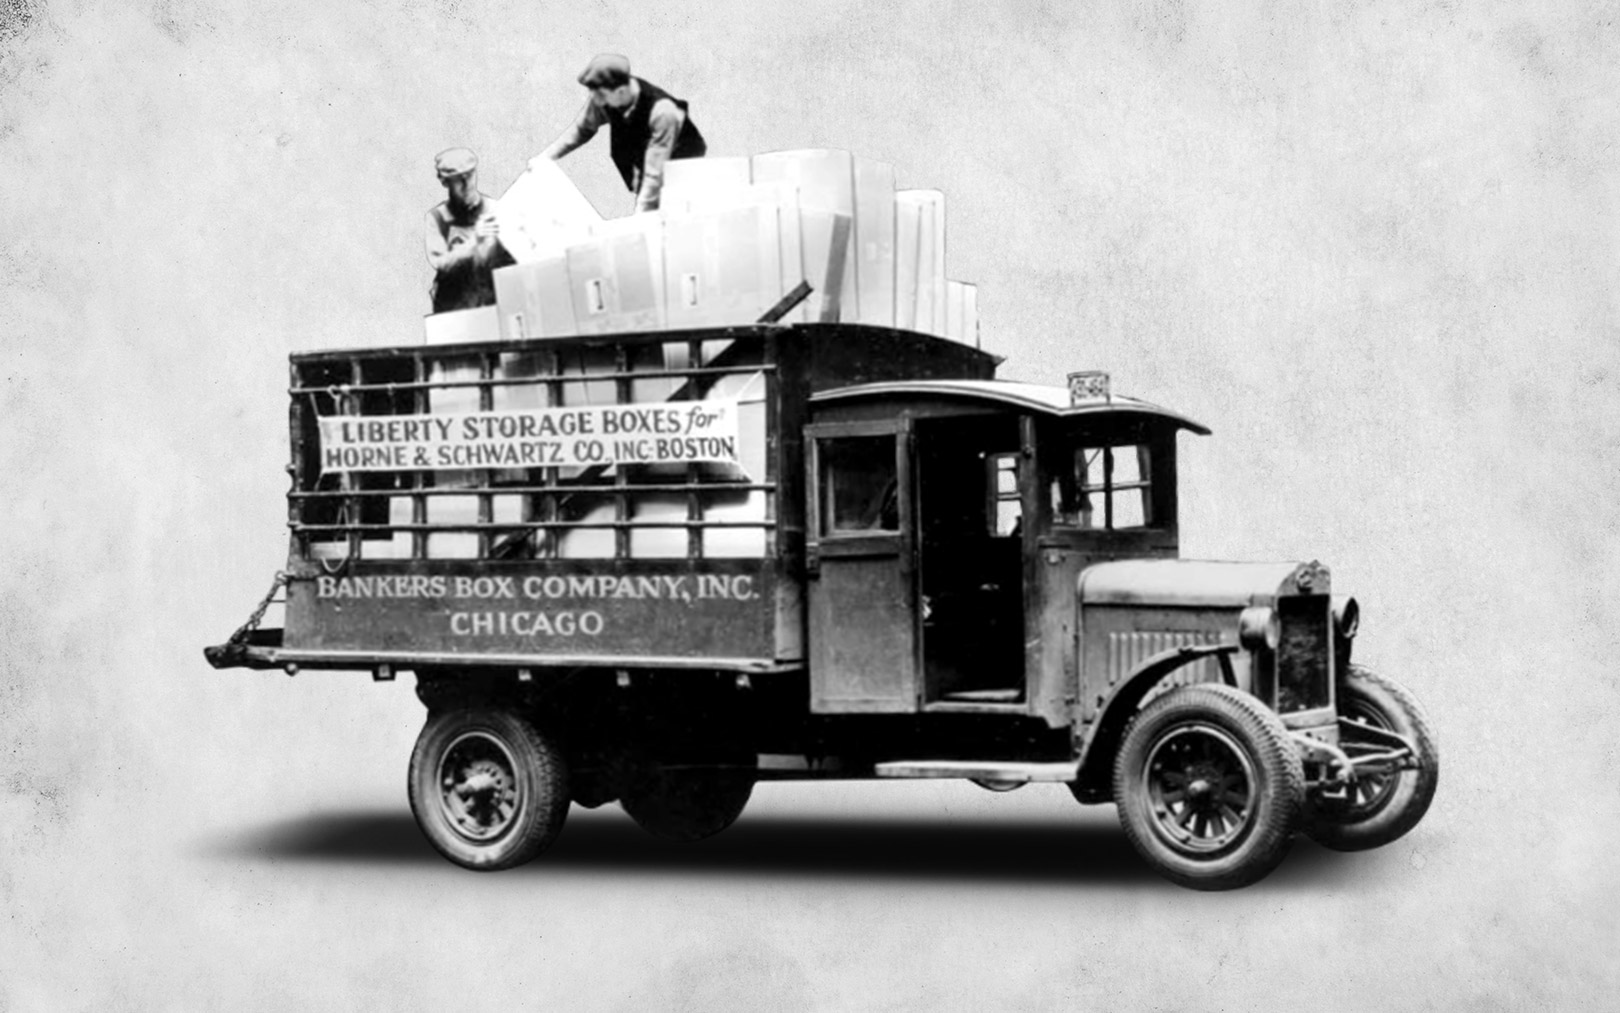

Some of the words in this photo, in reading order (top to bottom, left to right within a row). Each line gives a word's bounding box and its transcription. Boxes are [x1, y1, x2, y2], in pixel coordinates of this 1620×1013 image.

[343, 415, 453, 443] LIBERTY
[462, 407, 594, 439] STORAGE
[603, 409, 682, 434] BOXES
[684, 405, 719, 435] for
[326, 446, 408, 468] HORNE
[413, 446, 430, 466] &
[437, 440, 564, 466] SCHWARTZ
[656, 436, 736, 459] BOSTON
[317, 576, 447, 599] BANKERS
[454, 576, 515, 599] BOX
[522, 575, 690, 603] COMPANY,
[697, 574, 761, 600] INC.
[450, 611, 604, 636] CHICAGO
